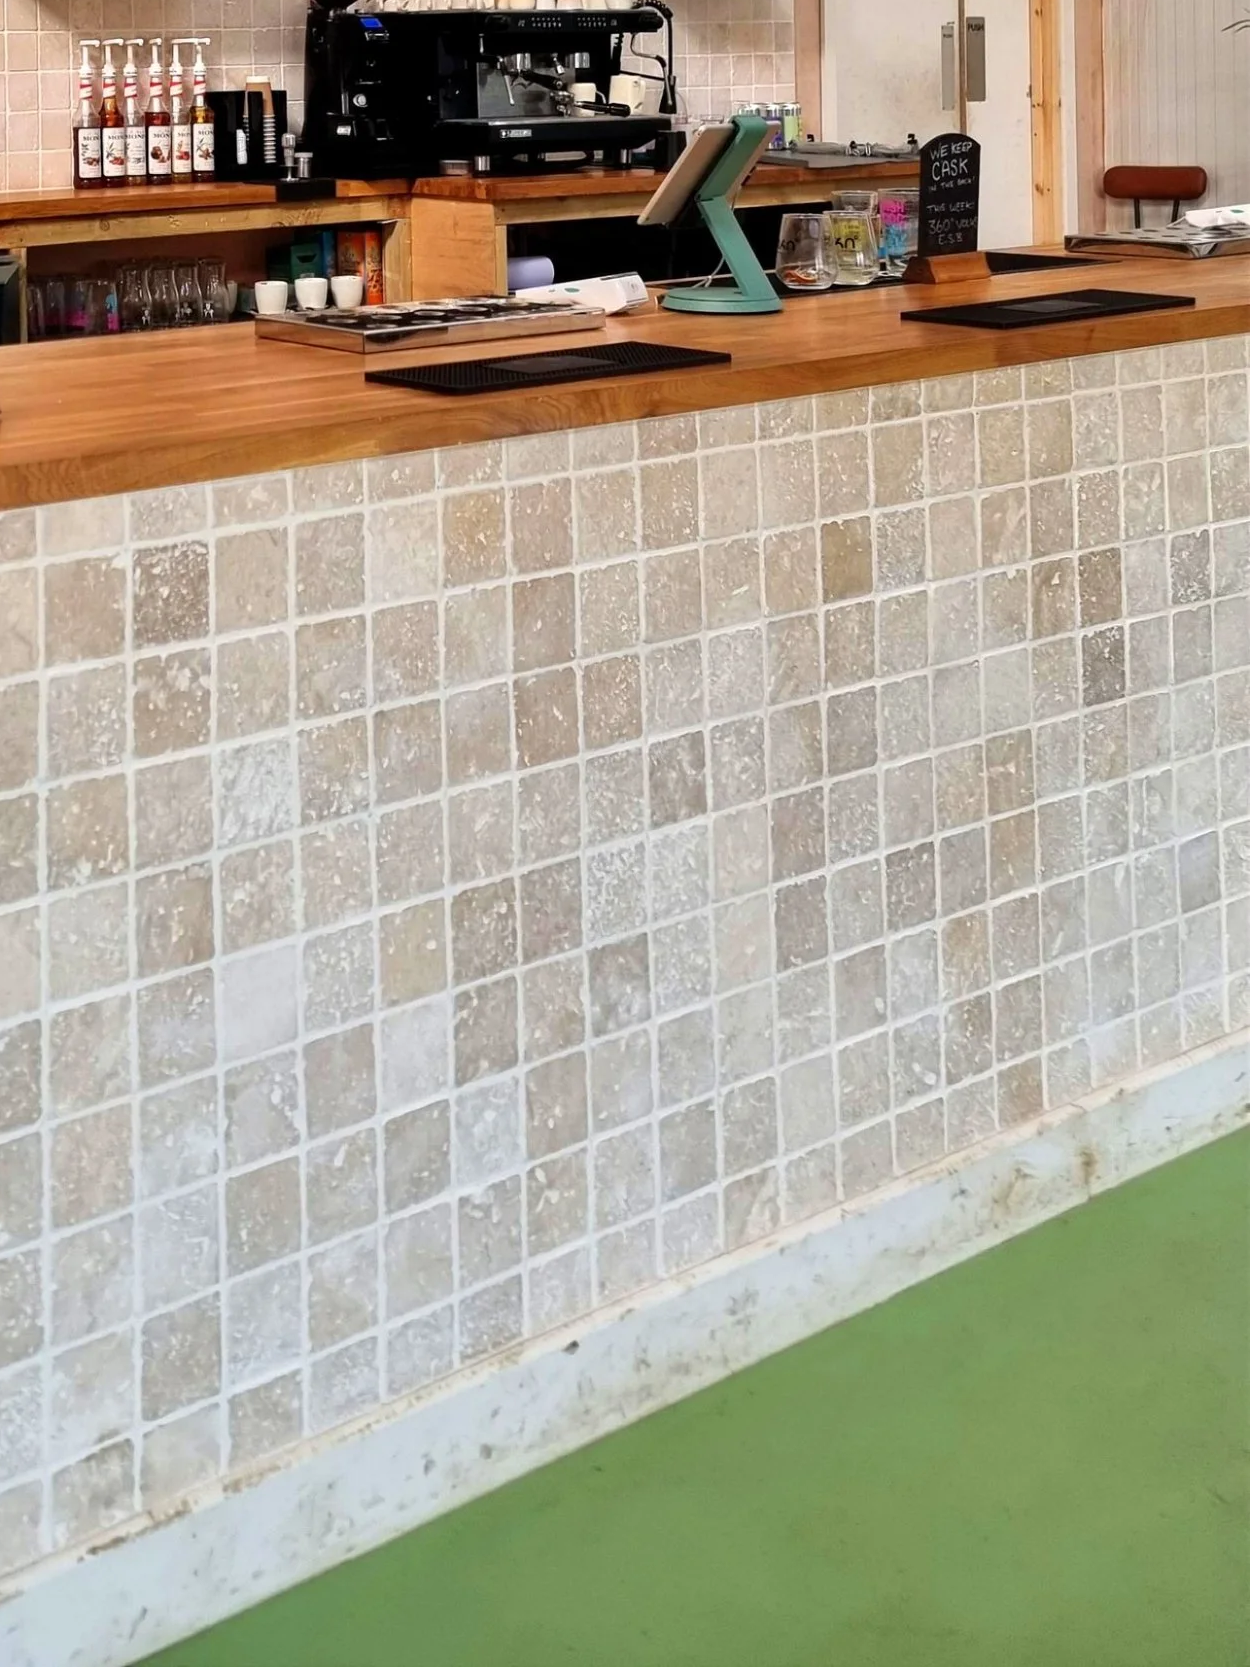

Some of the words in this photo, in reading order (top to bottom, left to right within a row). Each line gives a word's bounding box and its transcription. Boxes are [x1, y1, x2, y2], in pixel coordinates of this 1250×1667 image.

[930, 143, 948, 160] WE
[951, 141, 972, 154] KEEP
[932, 158, 968, 181] CASK
